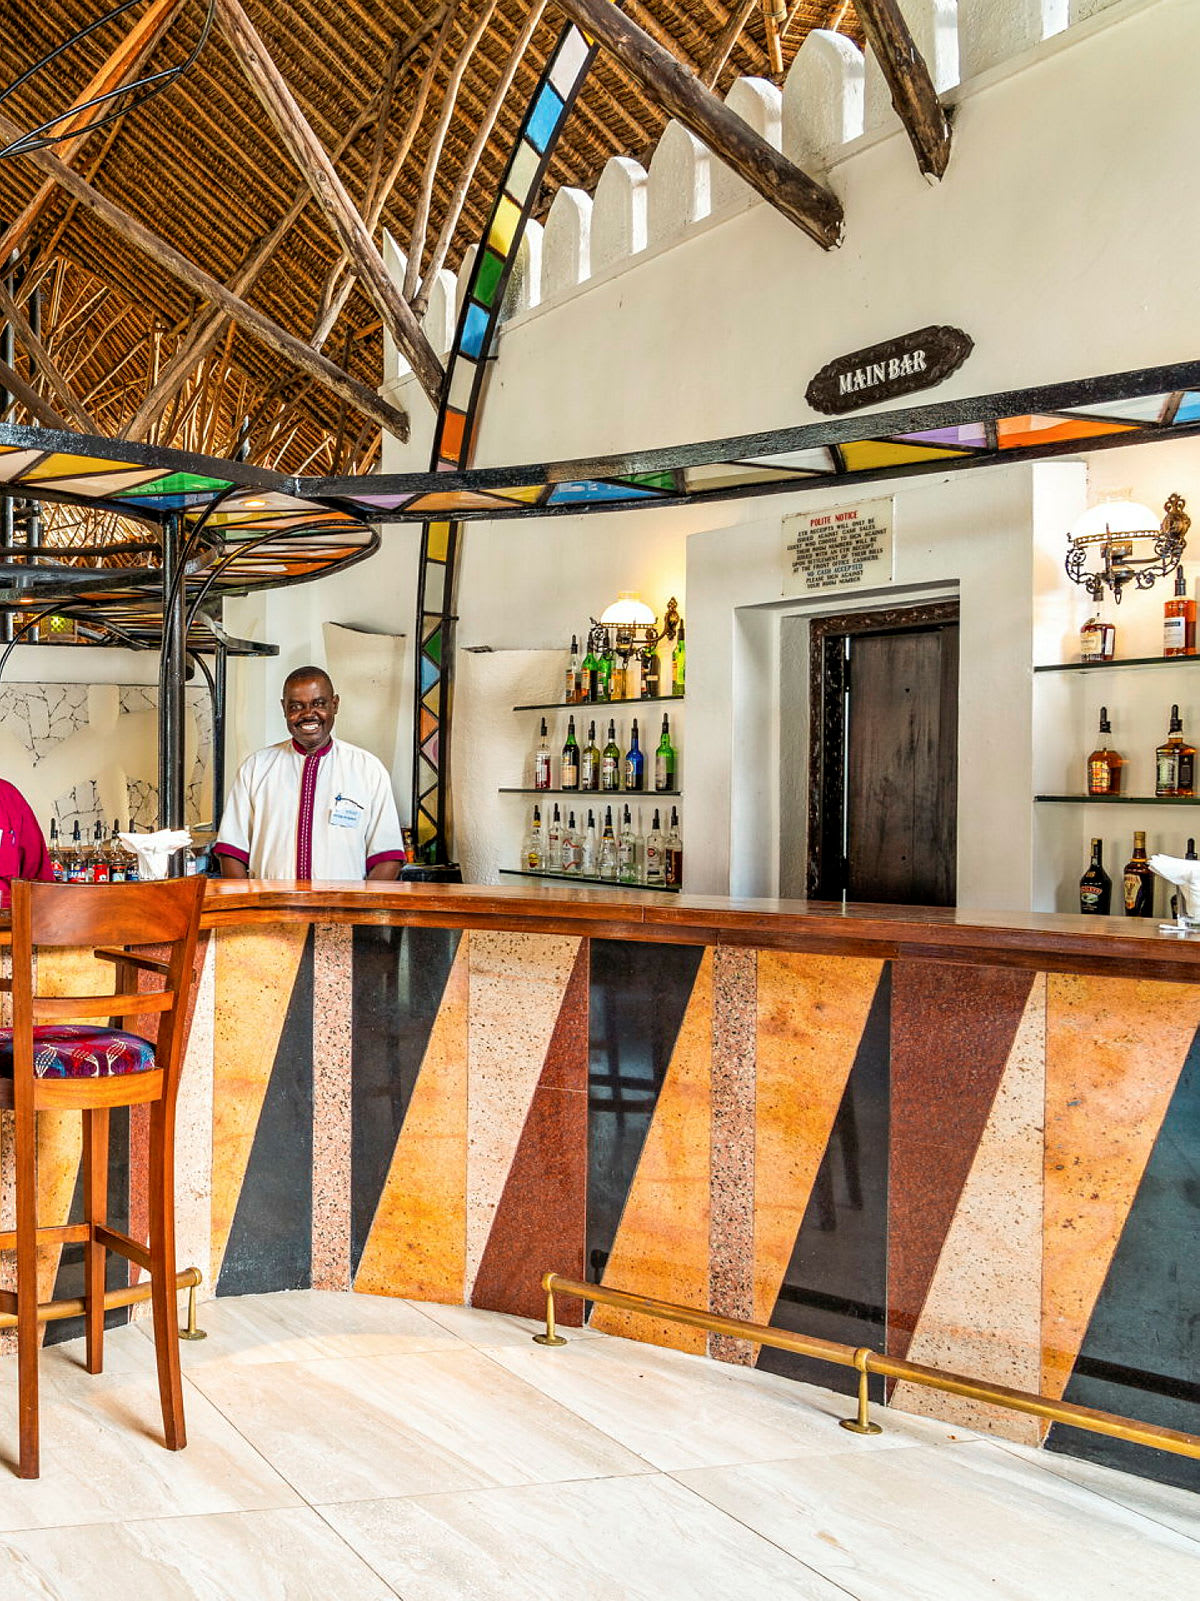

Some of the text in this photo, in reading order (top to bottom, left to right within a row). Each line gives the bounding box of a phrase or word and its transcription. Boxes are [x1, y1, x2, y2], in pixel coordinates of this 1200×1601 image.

[839, 349, 927, 395] MAIN BAR
[811, 511, 858, 527] POLITE NOTICE
[864, 529, 886, 537] AGAINST
[832, 559, 849, 567] OFFICE
[834, 563, 863, 574] ACCEPTED
[841, 570, 863, 579] AGAINST
